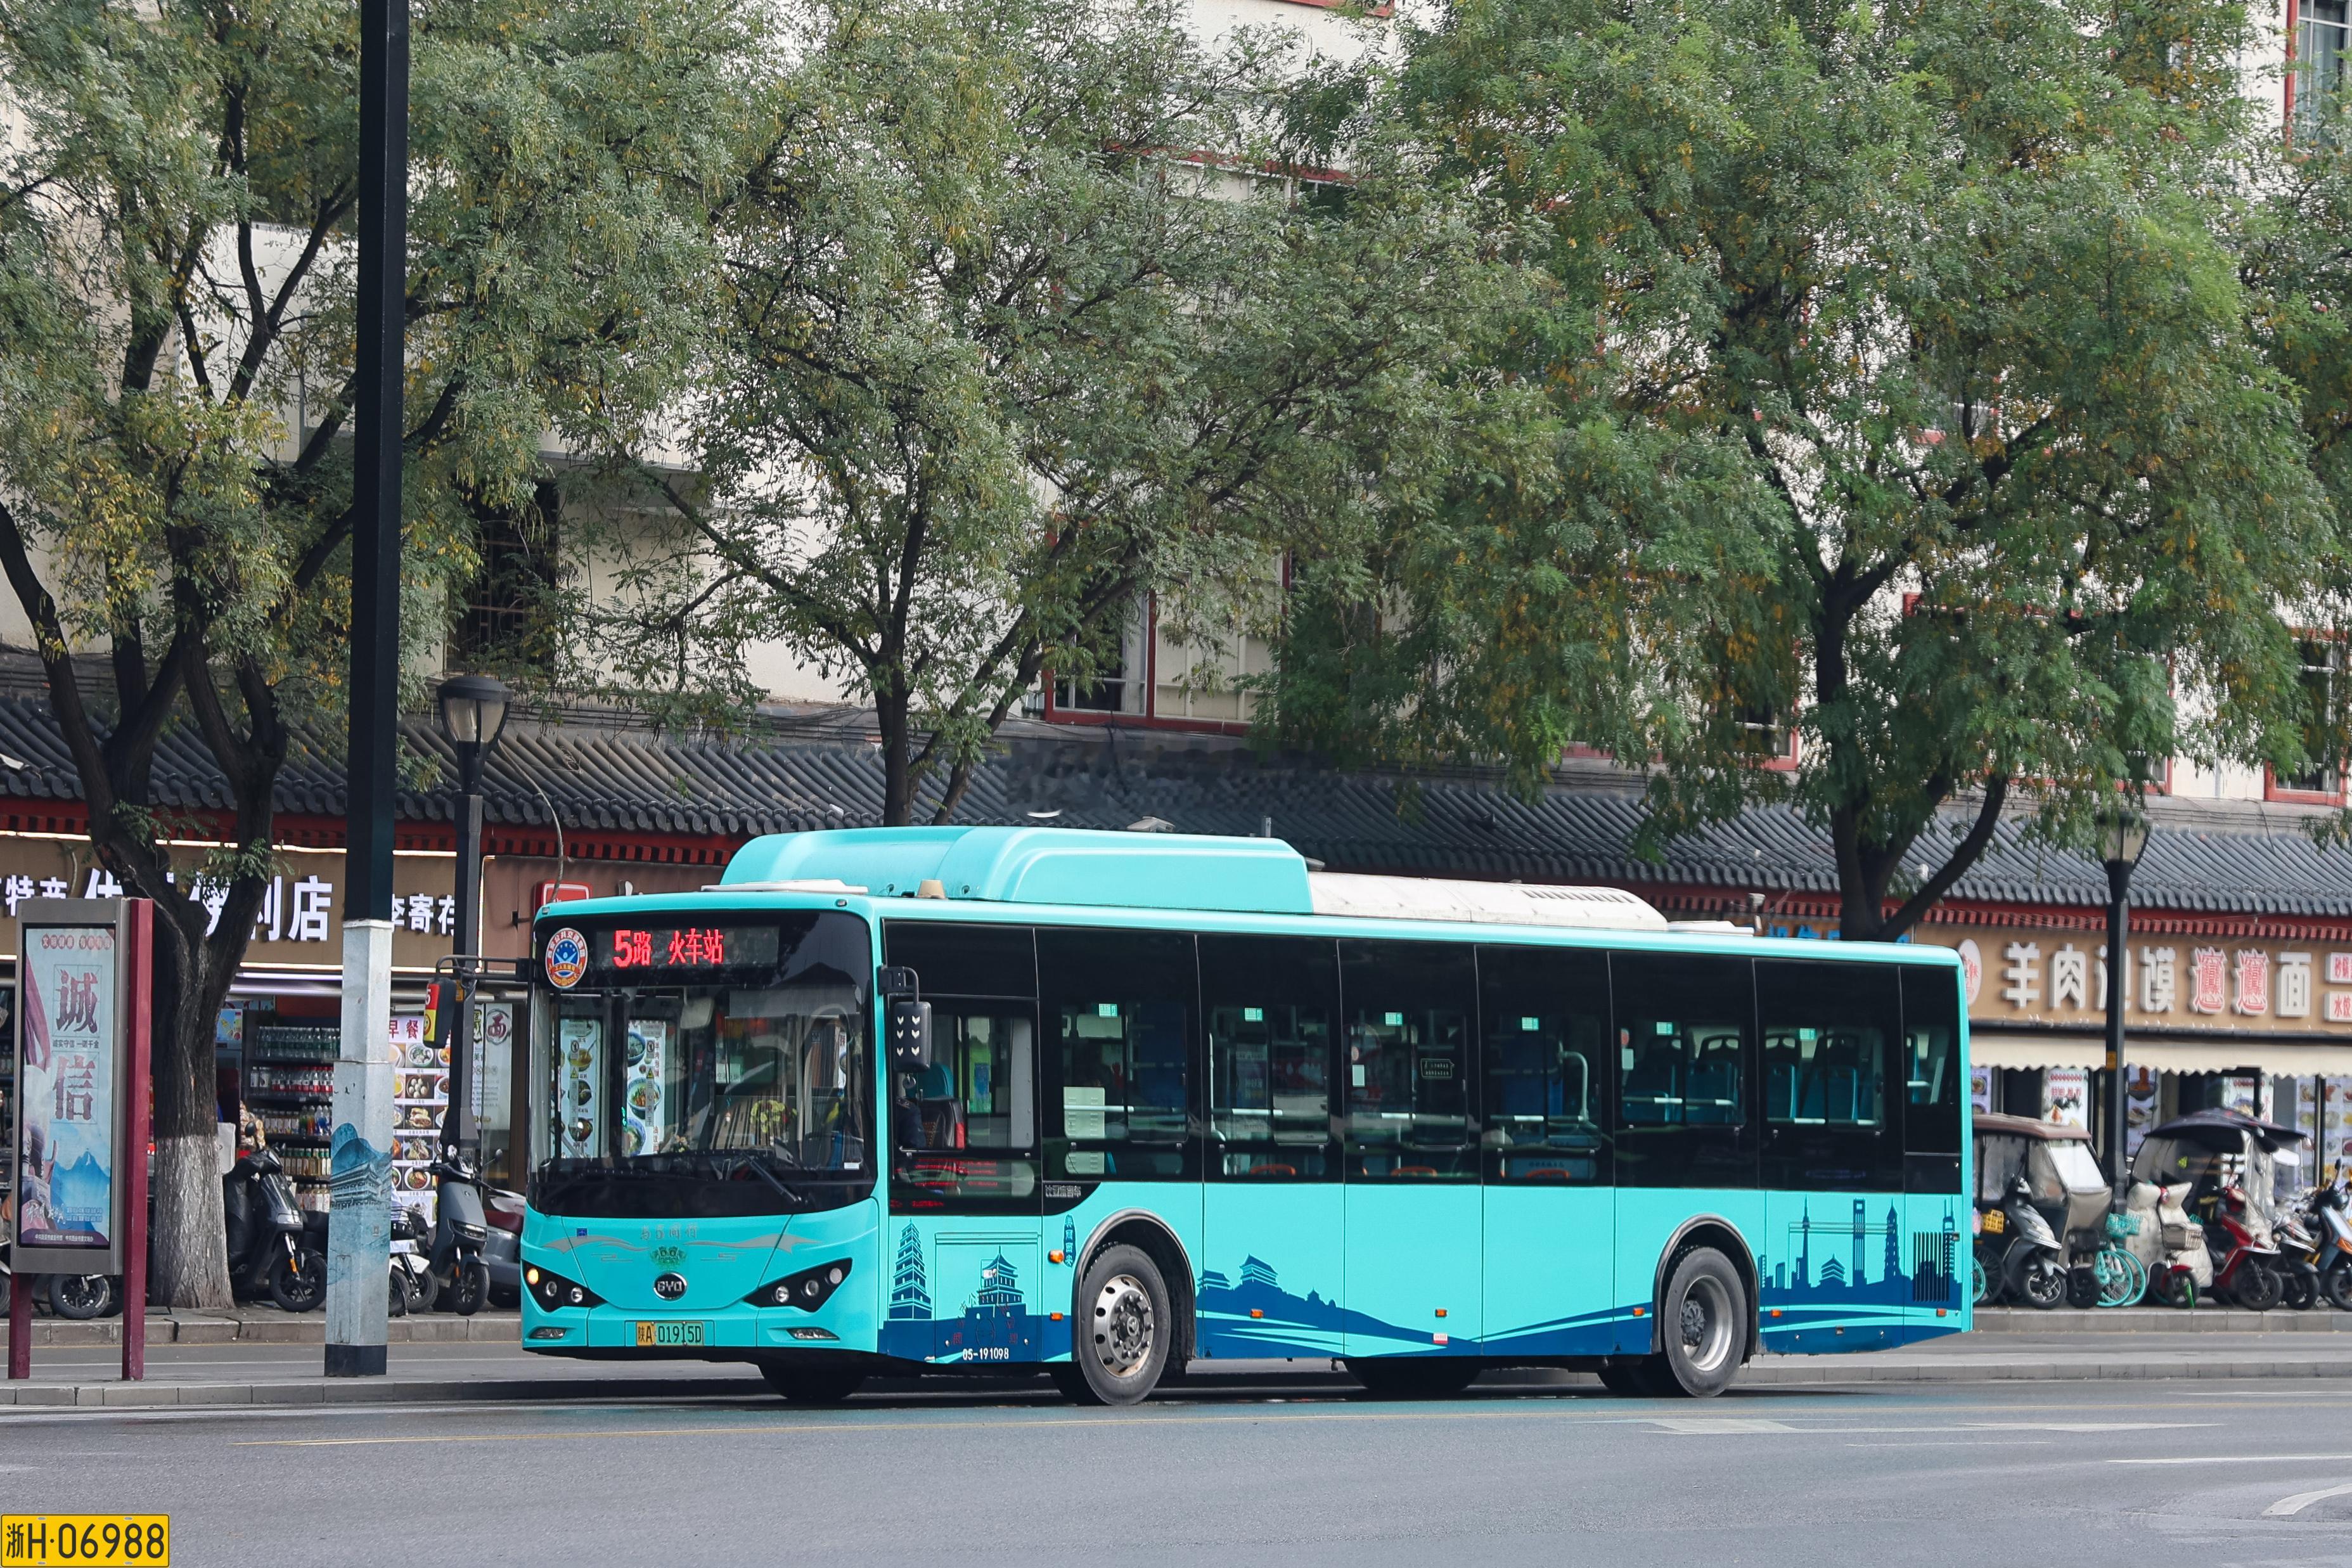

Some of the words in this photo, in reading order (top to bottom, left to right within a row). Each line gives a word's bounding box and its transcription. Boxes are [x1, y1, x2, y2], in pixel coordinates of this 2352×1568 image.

[0, 875, 67, 916] 特产
[614, 930, 652, 968] 5路
[668, 928, 724, 965] 火车站
[56, 969, 98, 1034] 诚
[53, 1039, 75, 1048] 诚实守信
[77, 1040, 99, 1049] 一诺千金
[389, 1019, 418, 1039] 早餐
[53, 1055, 96, 1121] 信
[657, 1280, 683, 1292] BYD
[963, 1347, 1010, 1361] 05-191098
